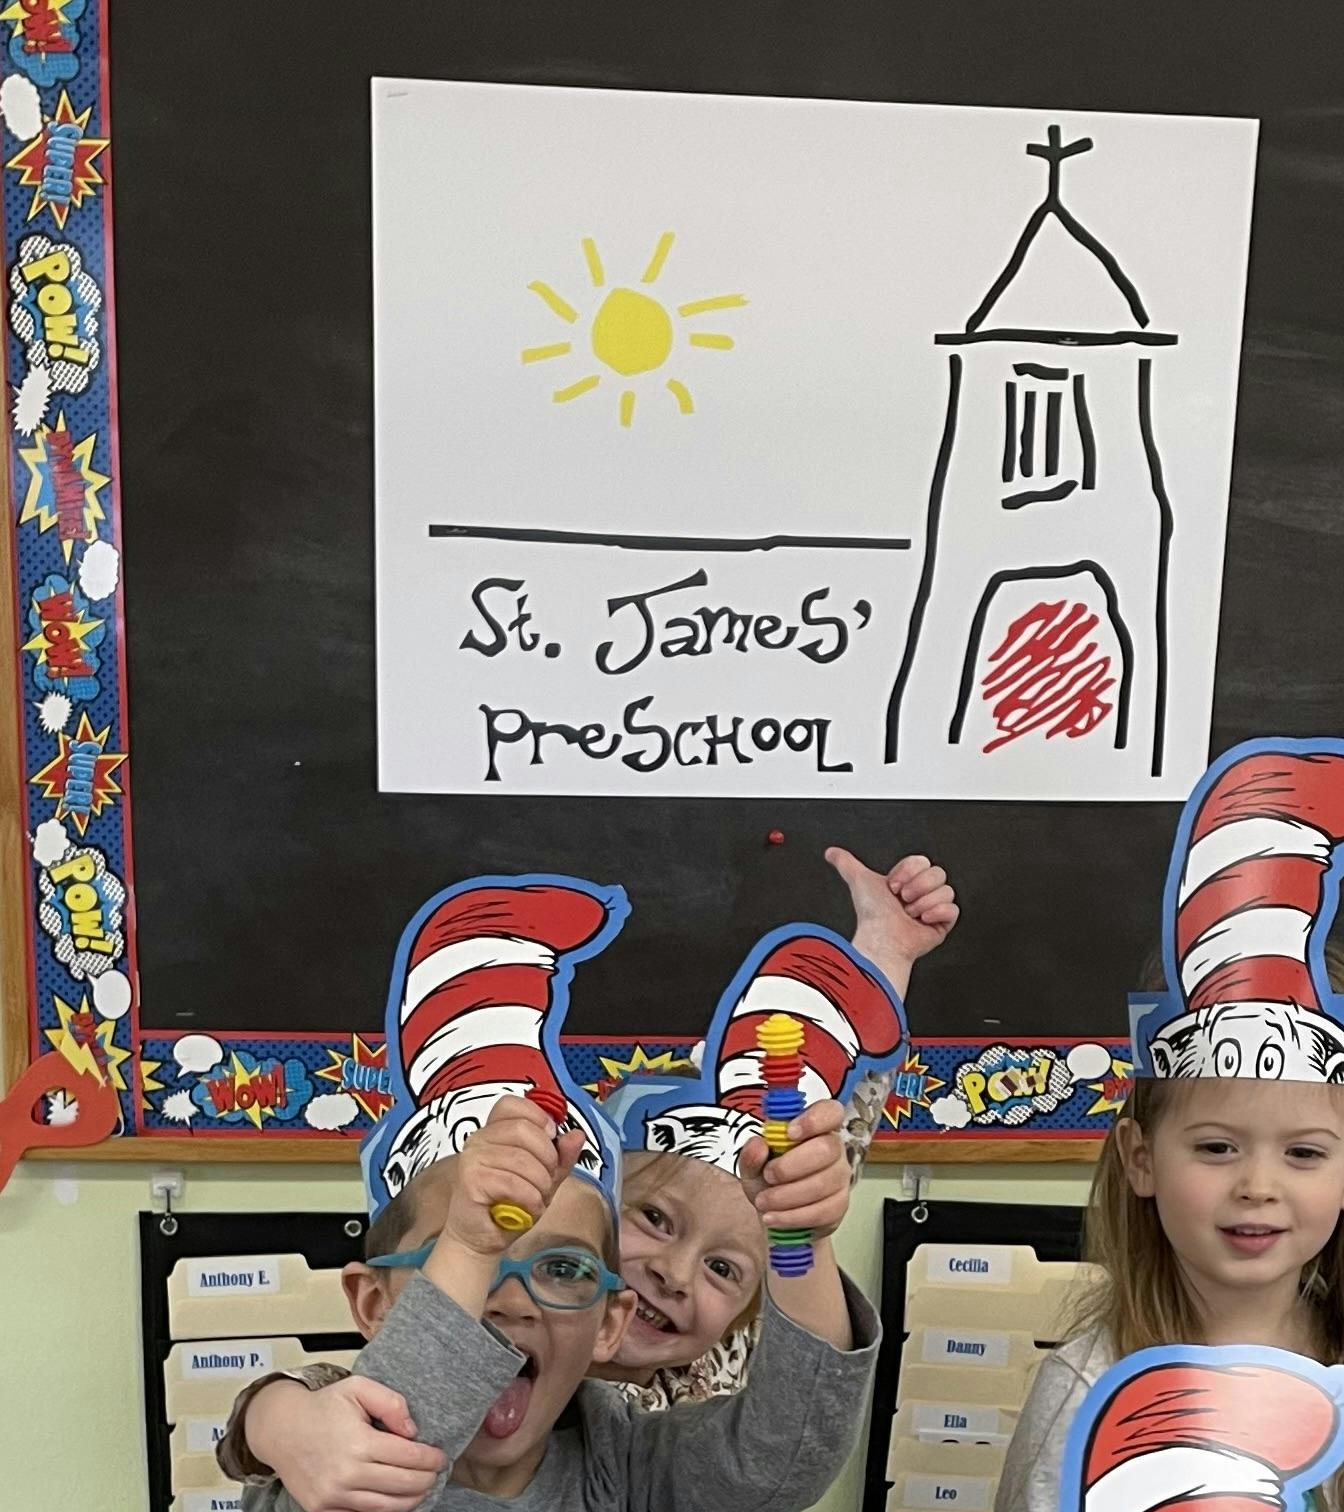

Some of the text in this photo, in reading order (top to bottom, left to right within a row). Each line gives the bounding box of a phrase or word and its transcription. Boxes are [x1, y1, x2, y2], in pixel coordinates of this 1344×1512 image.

[21, 250, 90, 364] POW!
[459, 577, 562, 659] St.
[37, 591, 97, 680] WOW!
[49, 854, 115, 954] POW!
[208, 1062, 287, 1111] WOW!
[948, 1257, 990, 1274] Cecilia
[199, 1268, 271, 1289] Anthony E.
[946, 1339, 987, 1357] Danny
[191, 1352, 265, 1371] Anthony P.
[943, 1413, 968, 1429] Ella
[935, 1485, 958, 1500] Leo
